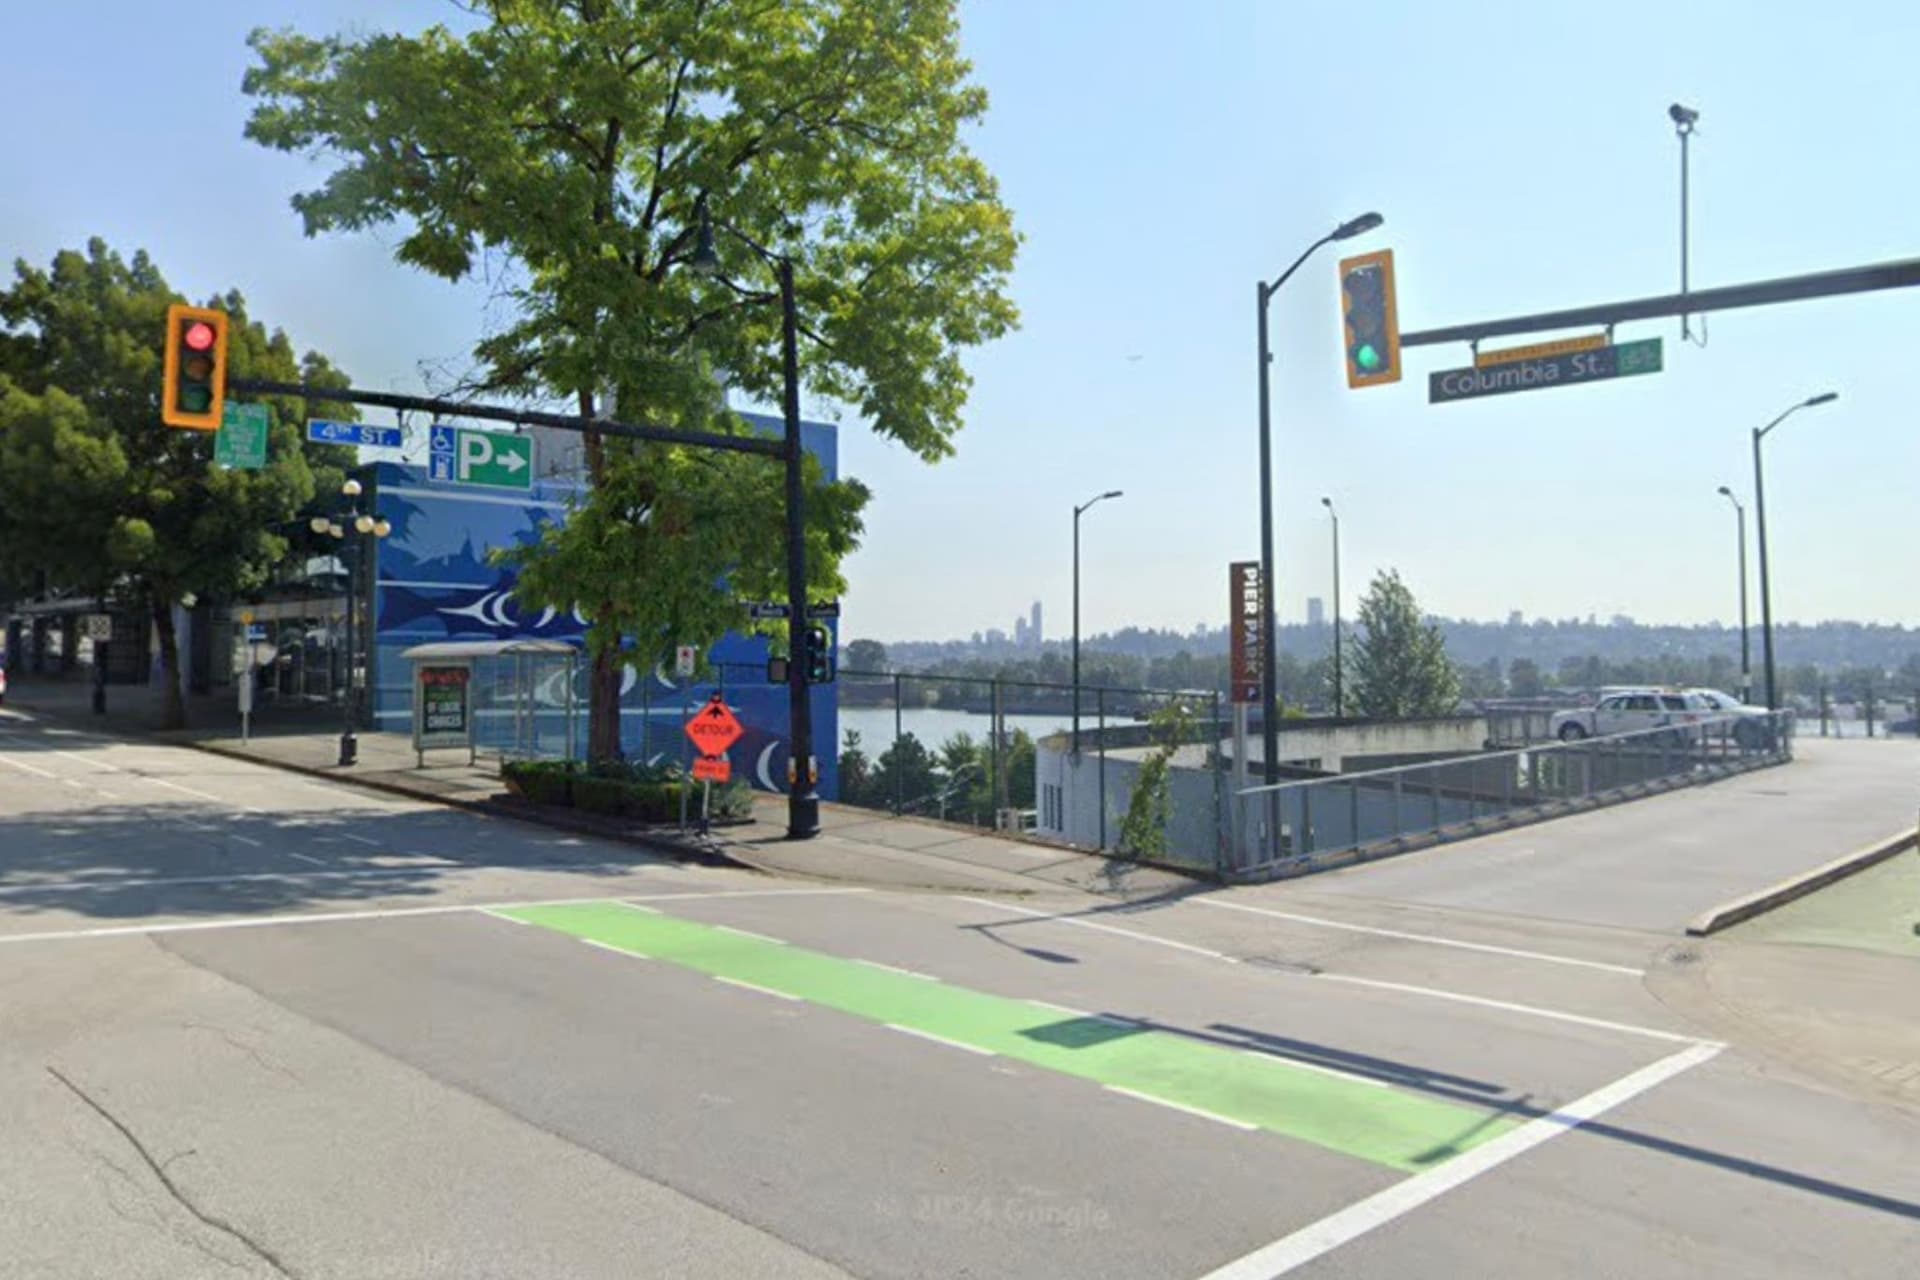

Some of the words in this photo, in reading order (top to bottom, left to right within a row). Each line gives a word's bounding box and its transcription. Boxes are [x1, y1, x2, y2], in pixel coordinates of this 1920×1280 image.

[1440, 360, 1560, 395] Columbia
[1571, 354, 1606, 377] St.
[321, 423, 352, 439] 4TH
[361, 428, 392, 445] ST.
[459, 432, 494, 480] P
[1243, 567, 1258, 614] PIER
[1243, 619, 1258, 673] PARK
[692, 723, 734, 736] DETOUR
